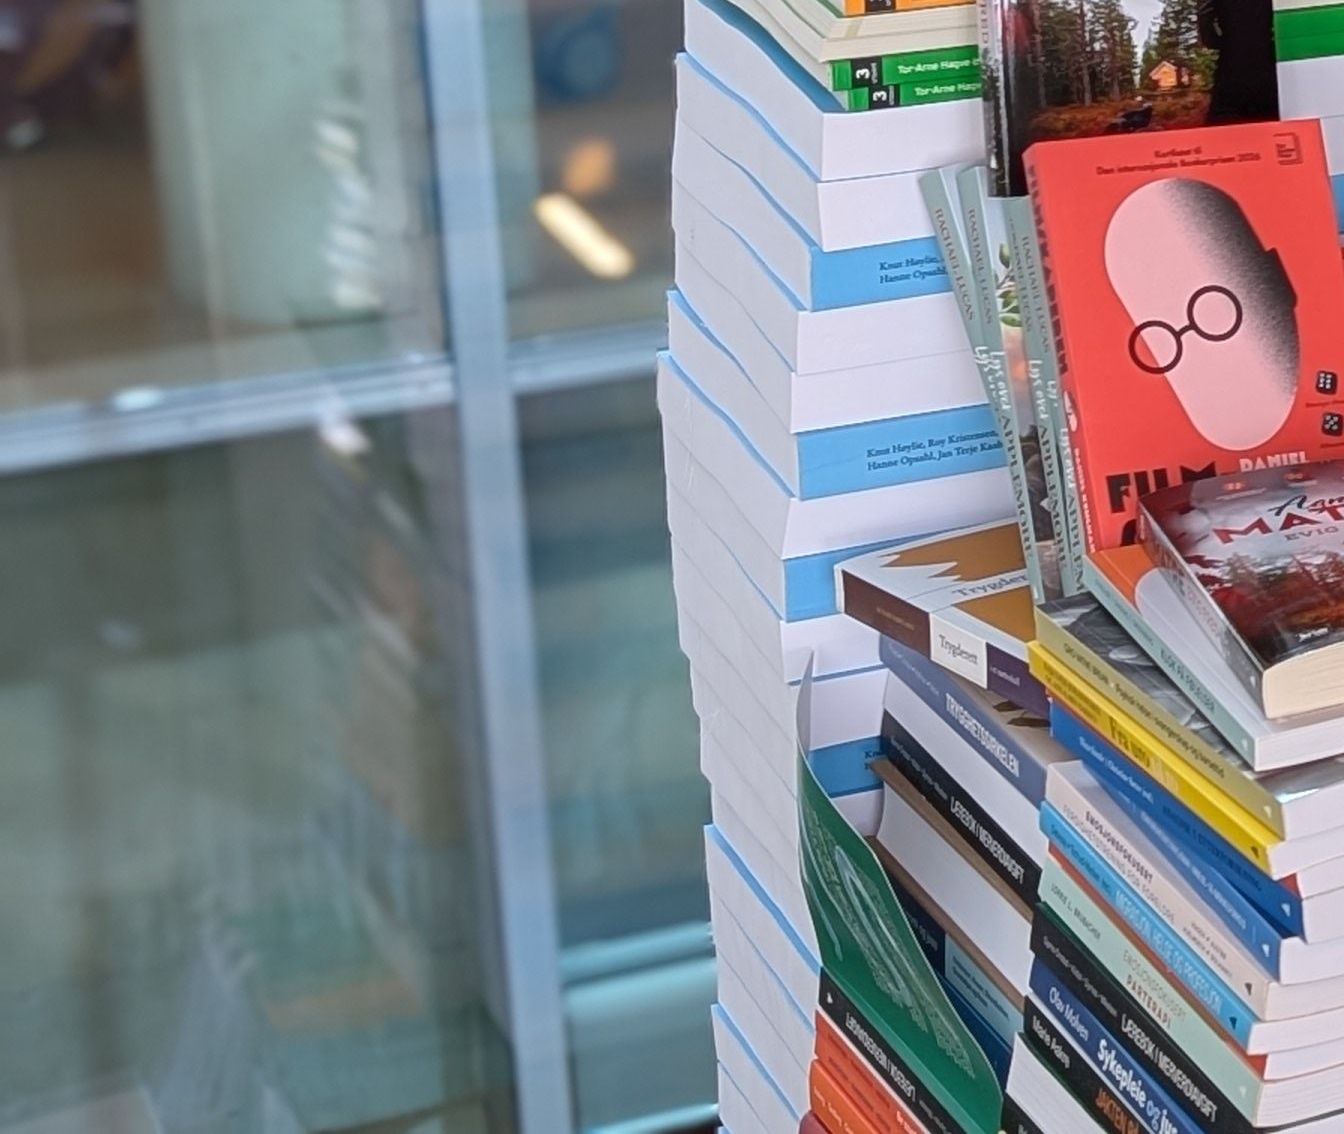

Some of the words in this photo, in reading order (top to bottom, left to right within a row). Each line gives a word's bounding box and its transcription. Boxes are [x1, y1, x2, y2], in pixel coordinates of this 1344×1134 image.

[1239, 450, 1309, 472] DANIEL
[1284, 526, 1339, 542] EVIG
[1097, 1038, 1147, 1108] Sykepleie
